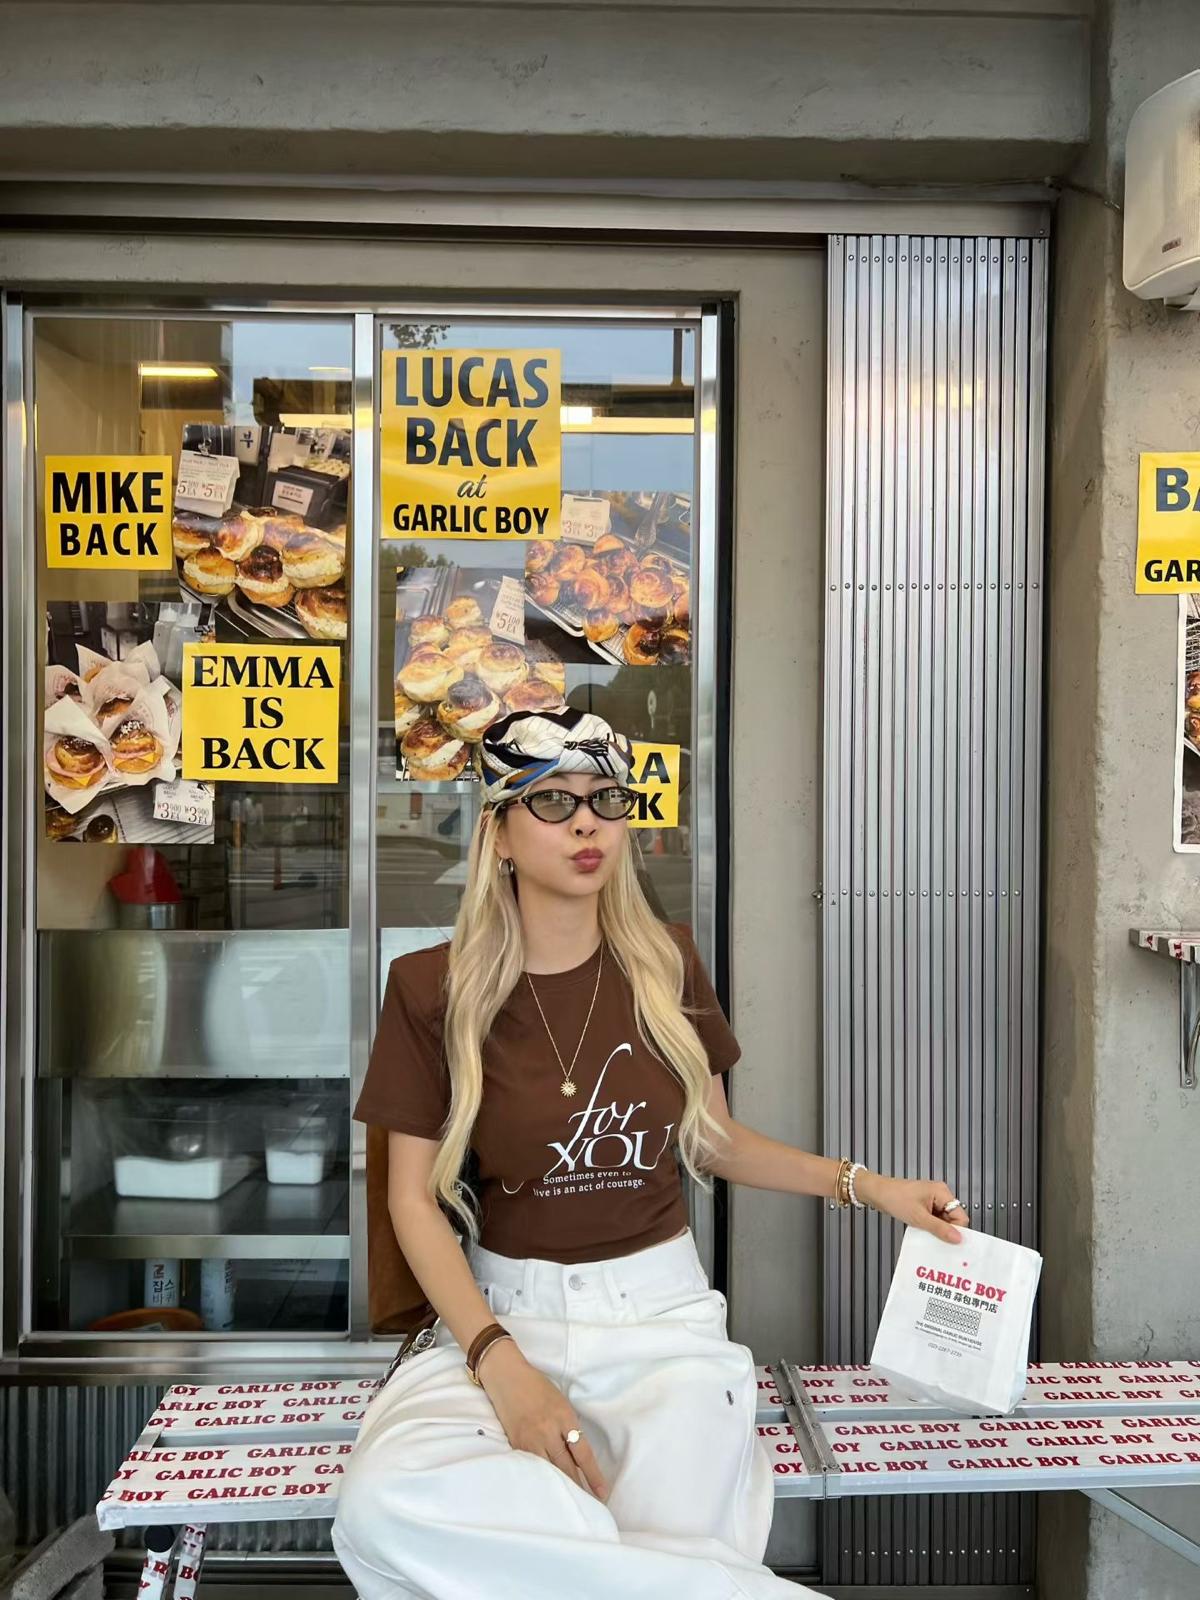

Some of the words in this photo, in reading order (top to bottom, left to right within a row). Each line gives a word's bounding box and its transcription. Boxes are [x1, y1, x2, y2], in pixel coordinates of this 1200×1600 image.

[395, 356, 549, 408] LUCAS
[406, 417, 538, 468] BACK
[51, 471, 164, 514] MIKE
[457, 474, 487, 499] at
[393, 503, 487, 533] GARLIC
[496, 506, 549, 535] BOY
[60, 522, 159, 556] BACK
[191, 655, 334, 689] EMMA
[242, 697, 283, 729] IS
[201, 737, 325, 770] BACK
[545, 1042, 647, 1177] for
[546, 1123, 675, 1172] YOU
[543, 1171, 595, 1185] Sometimes
[597, 1170, 619, 1178] even
[553, 1186, 561, 1196] is
[564, 1184, 576, 1194] an
[579, 1182, 593, 1193] act
[595, 1180, 605, 1190] of
[607, 1178, 646, 1189] courage.
[916, 1265, 972, 1292] GARLIC
[974, 1283, 1007, 1303] BOY
[1060, 1361, 1131, 1369] GARLIC
[1134, 1361, 1173, 1369] BOY
[171, 1386, 201, 1396] OY
[218, 1383, 295, 1395] GARLIC
[299, 1381, 342, 1392] BOY
[1062, 1375, 1102, 1384] BOY
[1119, 1374, 1193, 1384] GARLIC
[158, 1401, 218, 1412] ARLIC
[222, 1400, 267, 1410] BOY
[283, 1395, 361, 1407] GARLIC
[849, 1394, 888, 1403] BOY
[1043, 1391, 1120, 1400] GARLIC
[1122, 1390, 1163, 1399] BOY
[148, 1417, 179, 1428] OY
[195, 1415, 276, 1427] GARLIC
[280, 1412, 326, 1423] BOY
[835, 1424, 915, 1436] GARLIC
[919, 1423, 960, 1434] BOY
[979, 1421, 1059, 1432] GARLIC
[1061, 1419, 1104, 1430] BOY
[1121, 1417, 1200, 1428] GARLIC
[831, 1442, 860, 1453] OY
[880, 1439, 962, 1451] GARLIC
[964, 1438, 1008, 1449] BOY
[1026, 1435, 1109, 1447] GARLIC
[1110, 1433, 1154, 1445] BOY
[124, 1450, 178, 1462] RLIC
[181, 1449, 230, 1462] BOY
[247, 1445, 331, 1458] GARLIC
[773, 1462, 802, 1474] OY
[882, 1460, 928, 1472] BOY
[948, 1457, 1033, 1470] GARLIC
[1035, 1456, 1080, 1467] BOY
[1098, 1453, 1183, 1465] GARLIC
[155, 1467, 243, 1480] GARLIC
[247, 1465, 297, 1478] BOY
[118, 1489, 170, 1502] BOY
[187, 1485, 277, 1500] GARLIC
[282, 1482, 333, 1496] BOY
